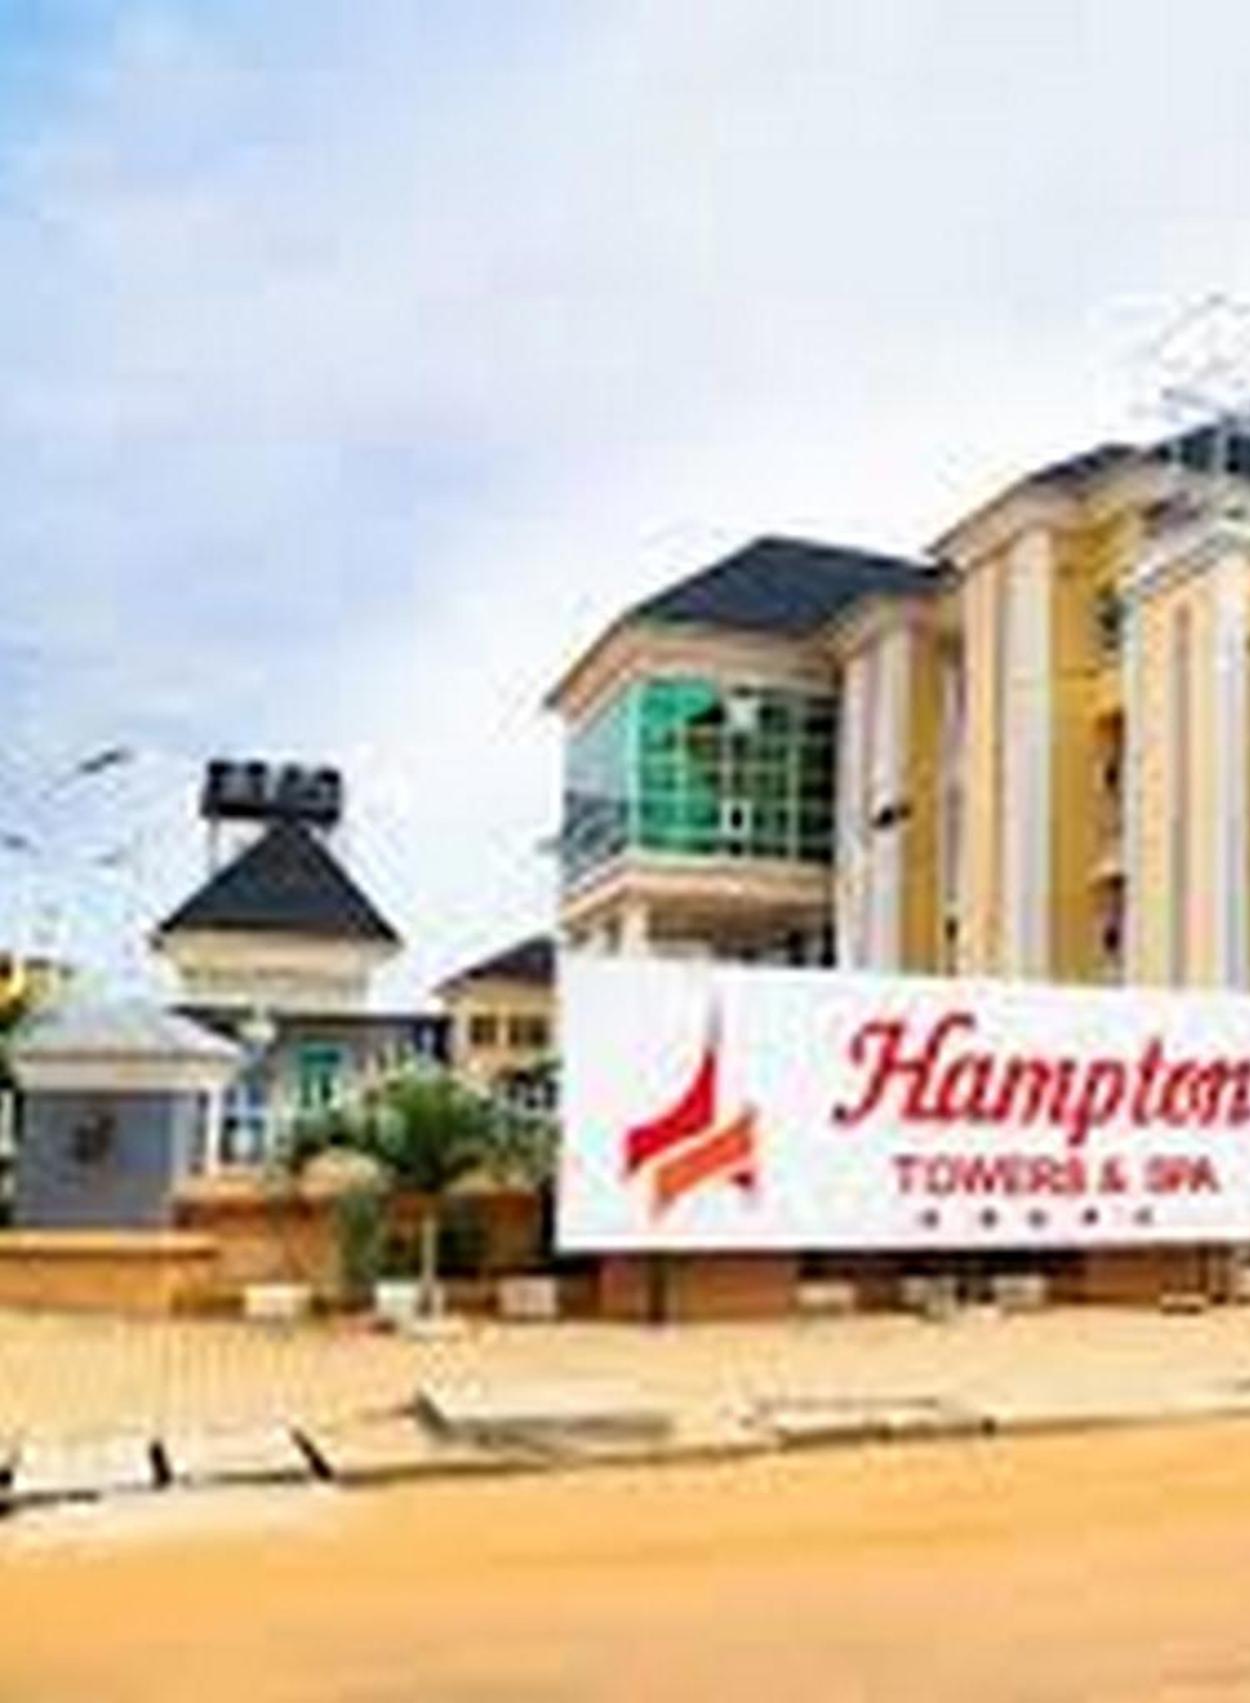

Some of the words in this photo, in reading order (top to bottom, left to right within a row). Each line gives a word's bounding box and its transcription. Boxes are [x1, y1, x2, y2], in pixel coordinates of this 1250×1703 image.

[893, 1154, 1085, 1196] TOWERS
[1099, 1157, 1128, 1195] &
[1142, 1155, 1221, 1196] SPA
